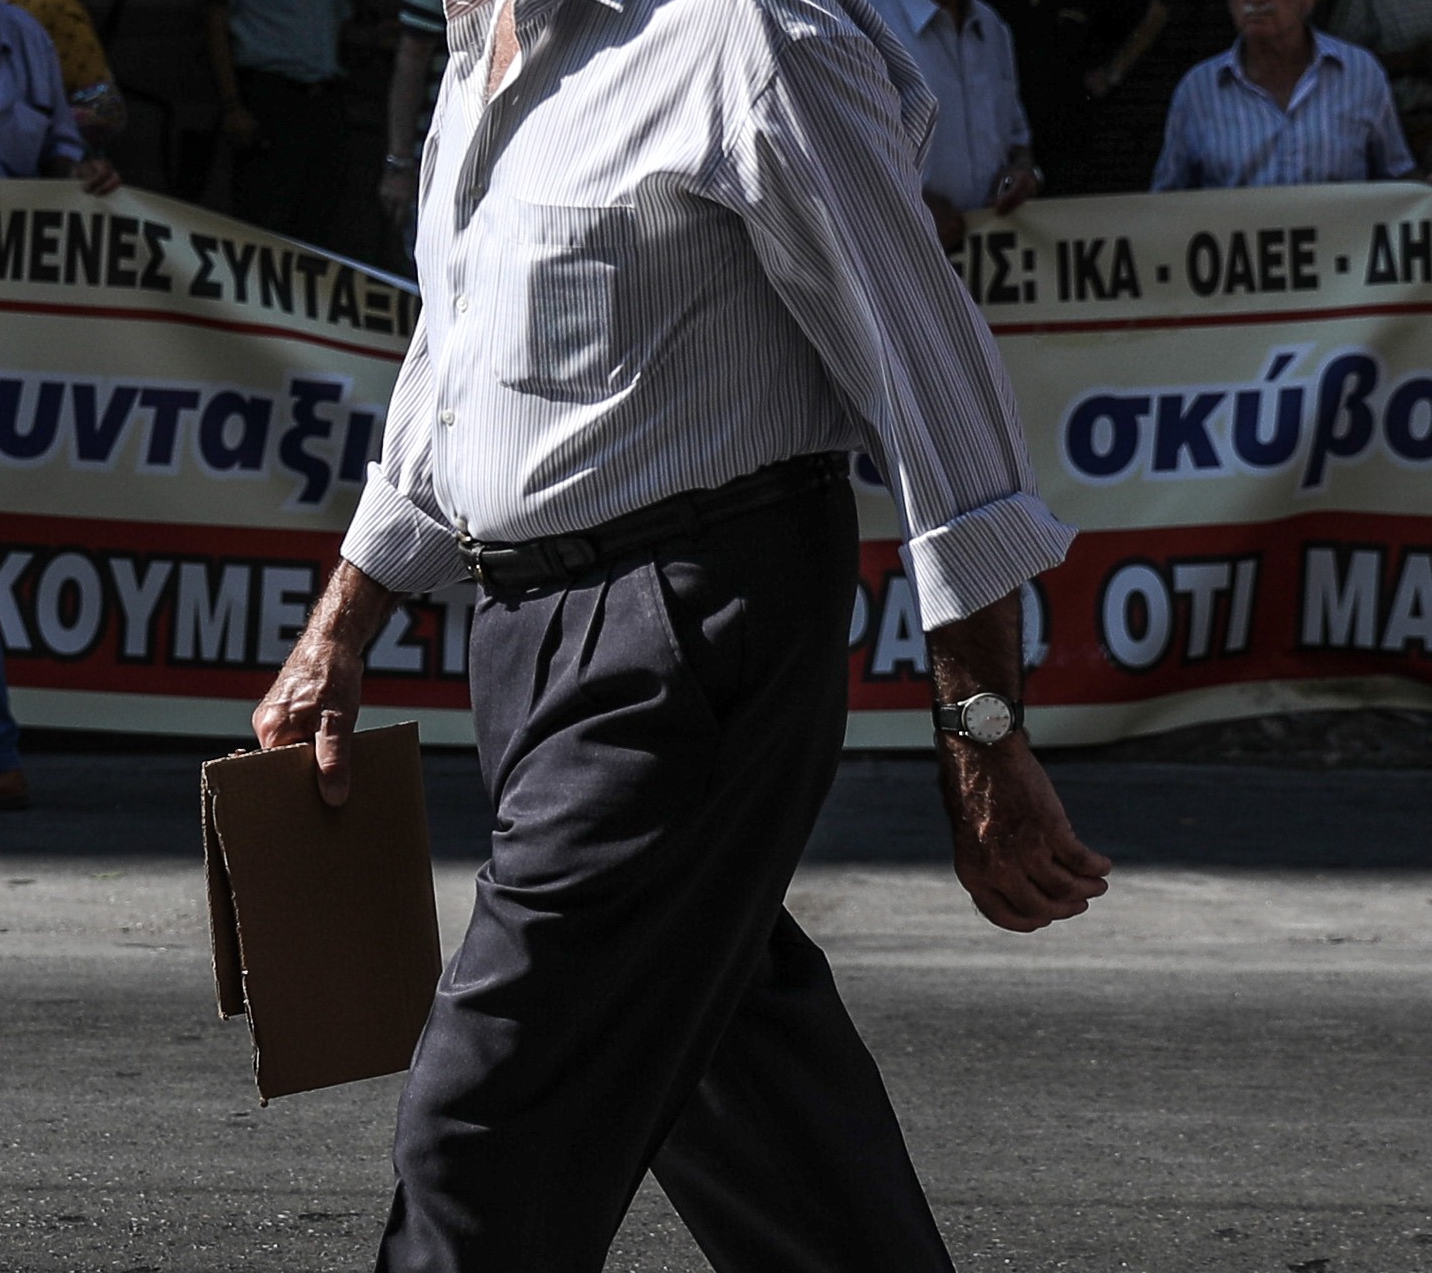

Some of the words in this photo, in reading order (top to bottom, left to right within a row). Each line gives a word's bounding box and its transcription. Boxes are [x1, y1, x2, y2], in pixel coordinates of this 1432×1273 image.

[188, 231, 420, 338] ΣΥΝΤΑΞΙ
[1056, 236, 1141, 303] ΙΚΑ
[1186, 227, 1319, 297] ΟΑΕΕ
[1102, 555, 1260, 670] ΟΤΙ
